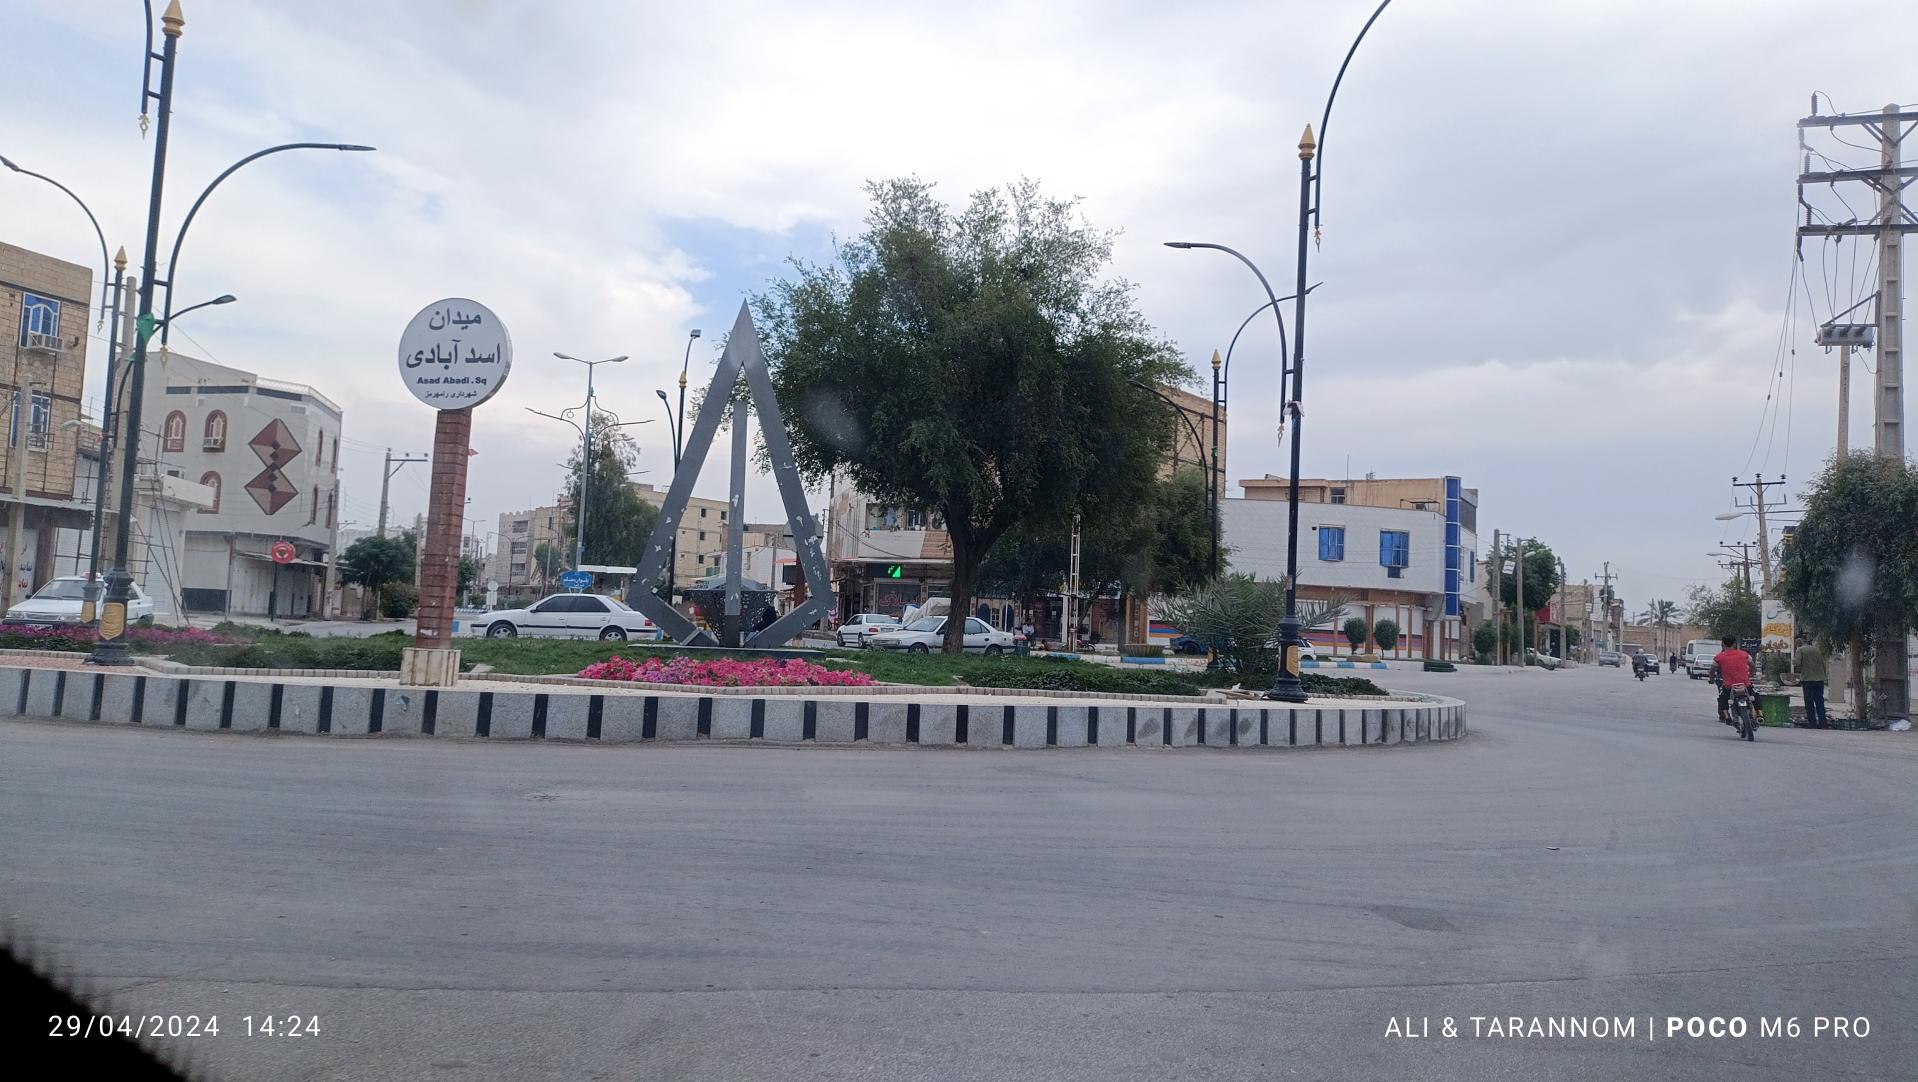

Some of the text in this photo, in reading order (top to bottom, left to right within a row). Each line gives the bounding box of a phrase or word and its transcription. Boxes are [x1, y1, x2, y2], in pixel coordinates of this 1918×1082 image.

[429, 307, 482, 330] میدان
[406, 339, 501, 370] اسد آبادی
[417, 376, 440, 384] Asad
[443, 376, 469, 384] Abadi
